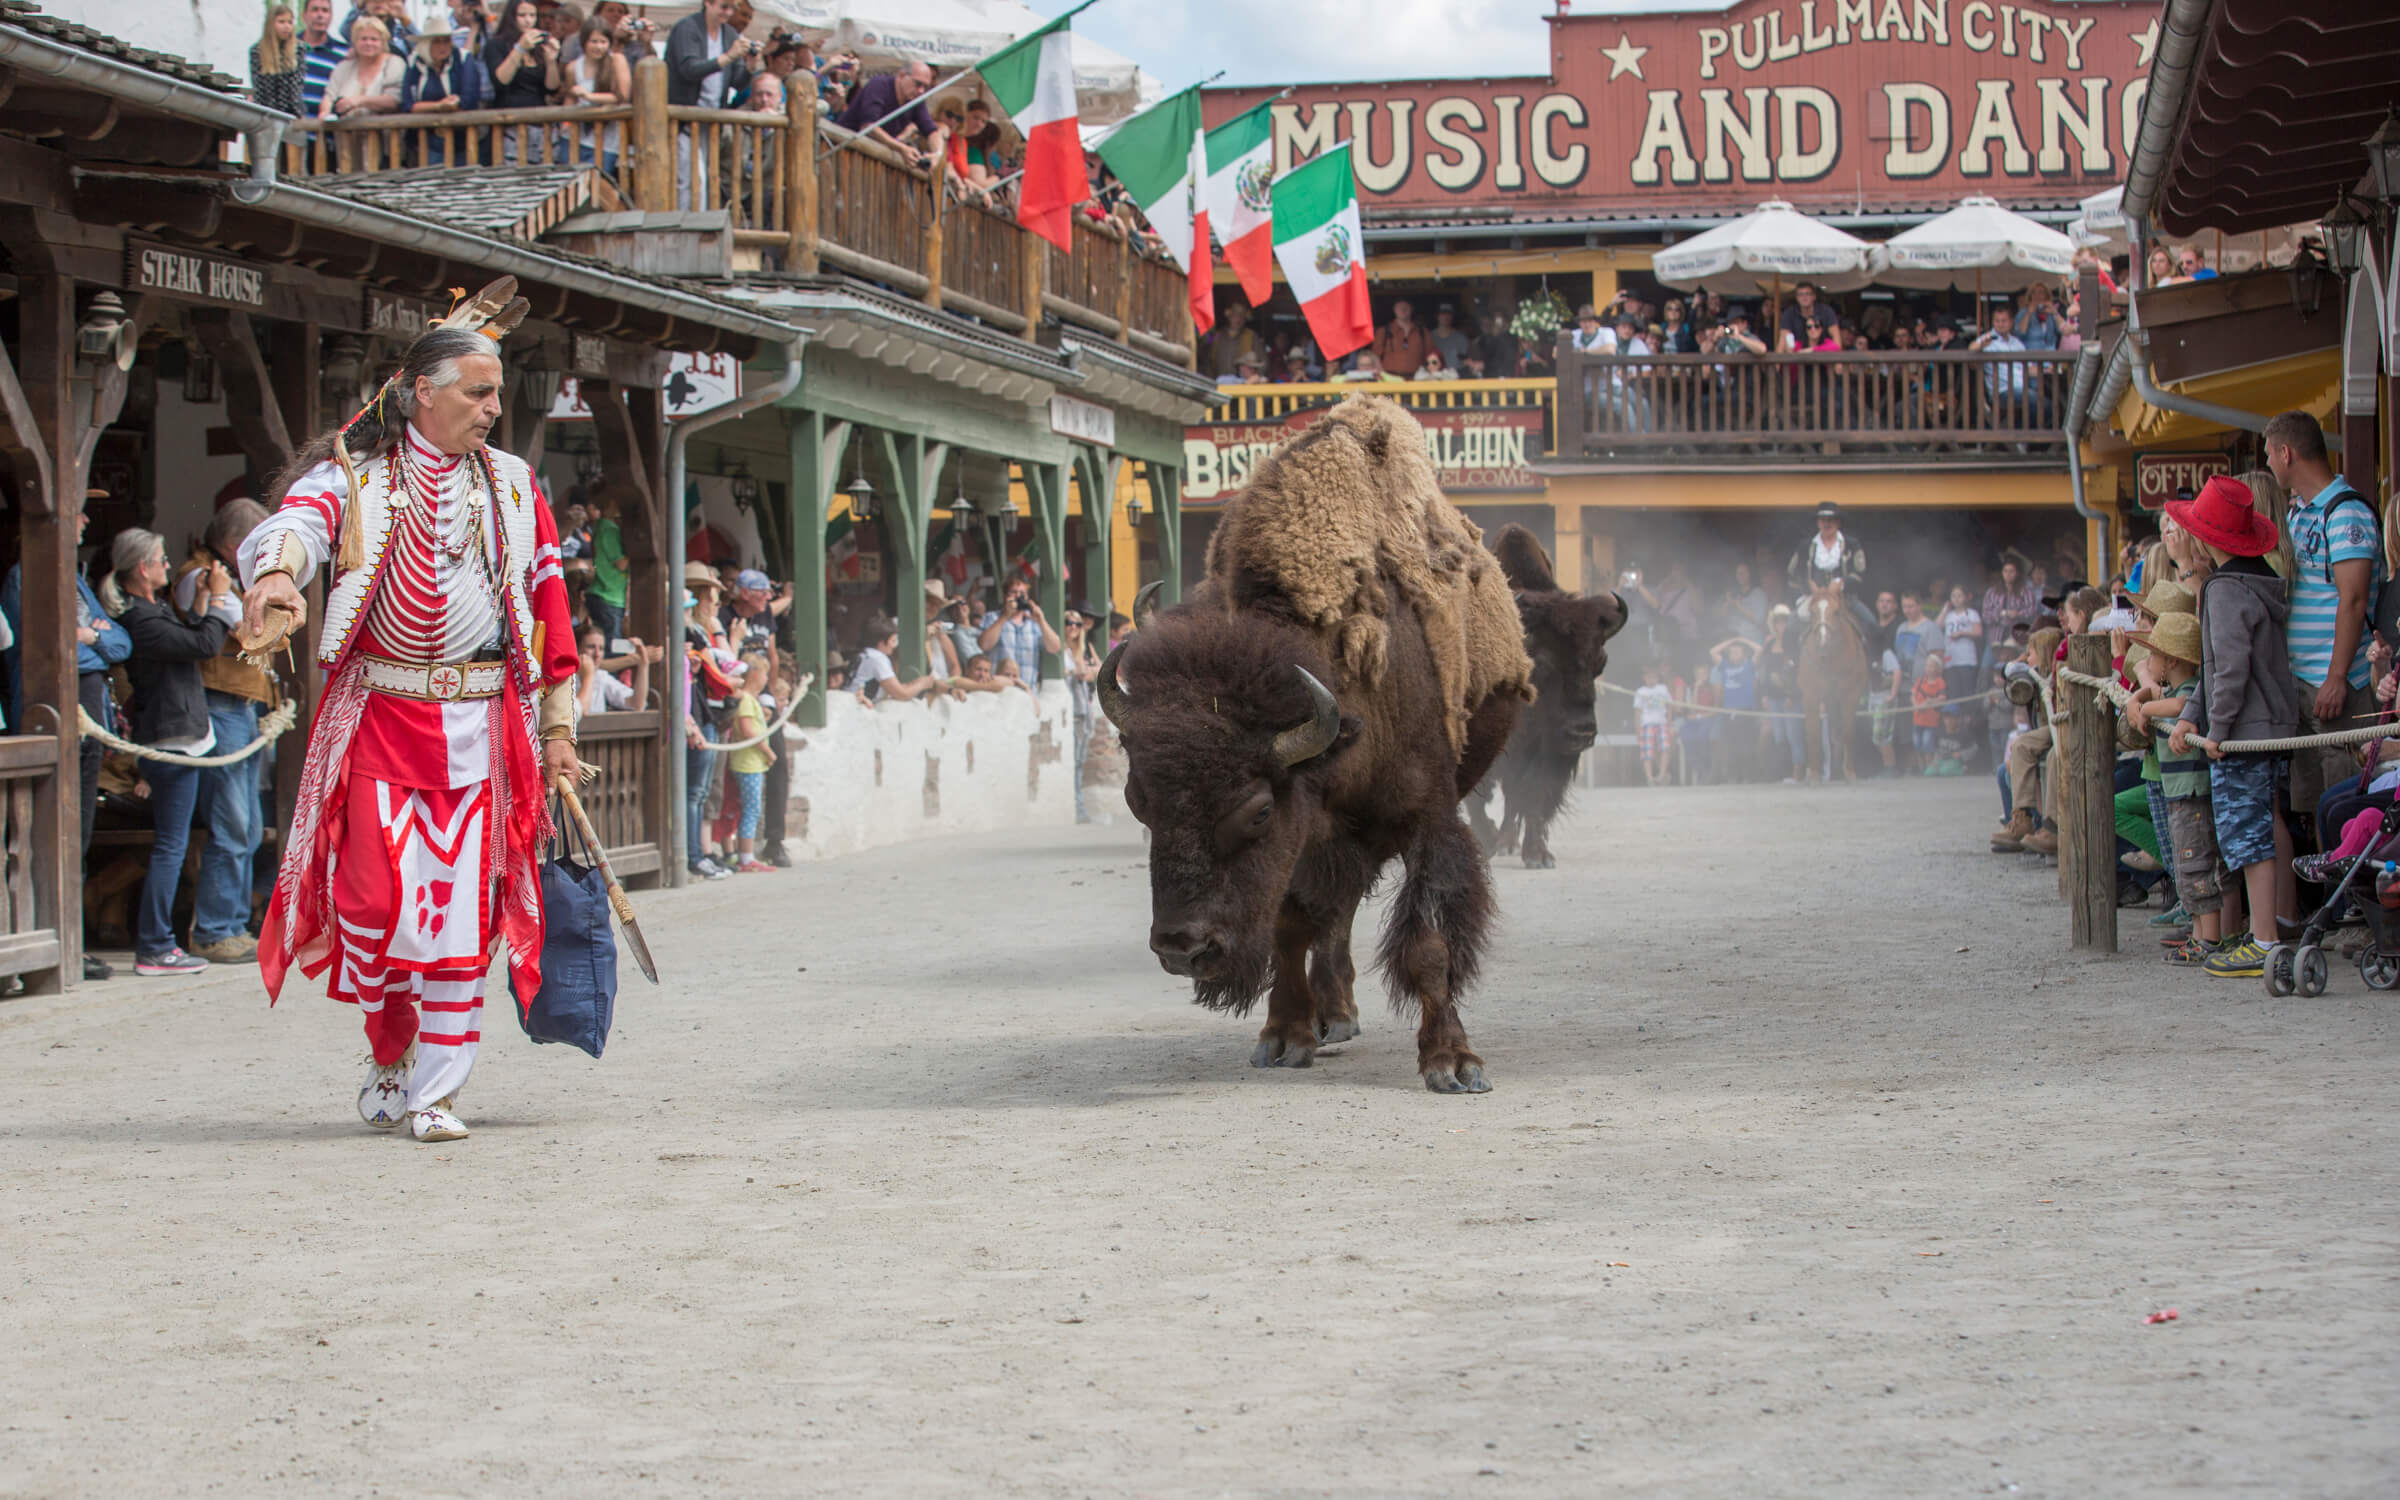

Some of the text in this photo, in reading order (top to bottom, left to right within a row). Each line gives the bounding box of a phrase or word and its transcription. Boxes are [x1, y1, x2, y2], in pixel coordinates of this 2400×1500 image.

[1700, 0, 2096, 79] PULLMAN CITY
[1270, 94, 1588, 192] MUSIC
[1631, 85, 1841, 184] AND
[141, 249, 263, 305] STEAK HOUSE
[1182, 426, 1531, 499] BIS ALOON
[1211, 412, 1494, 443] BLACK 1997
